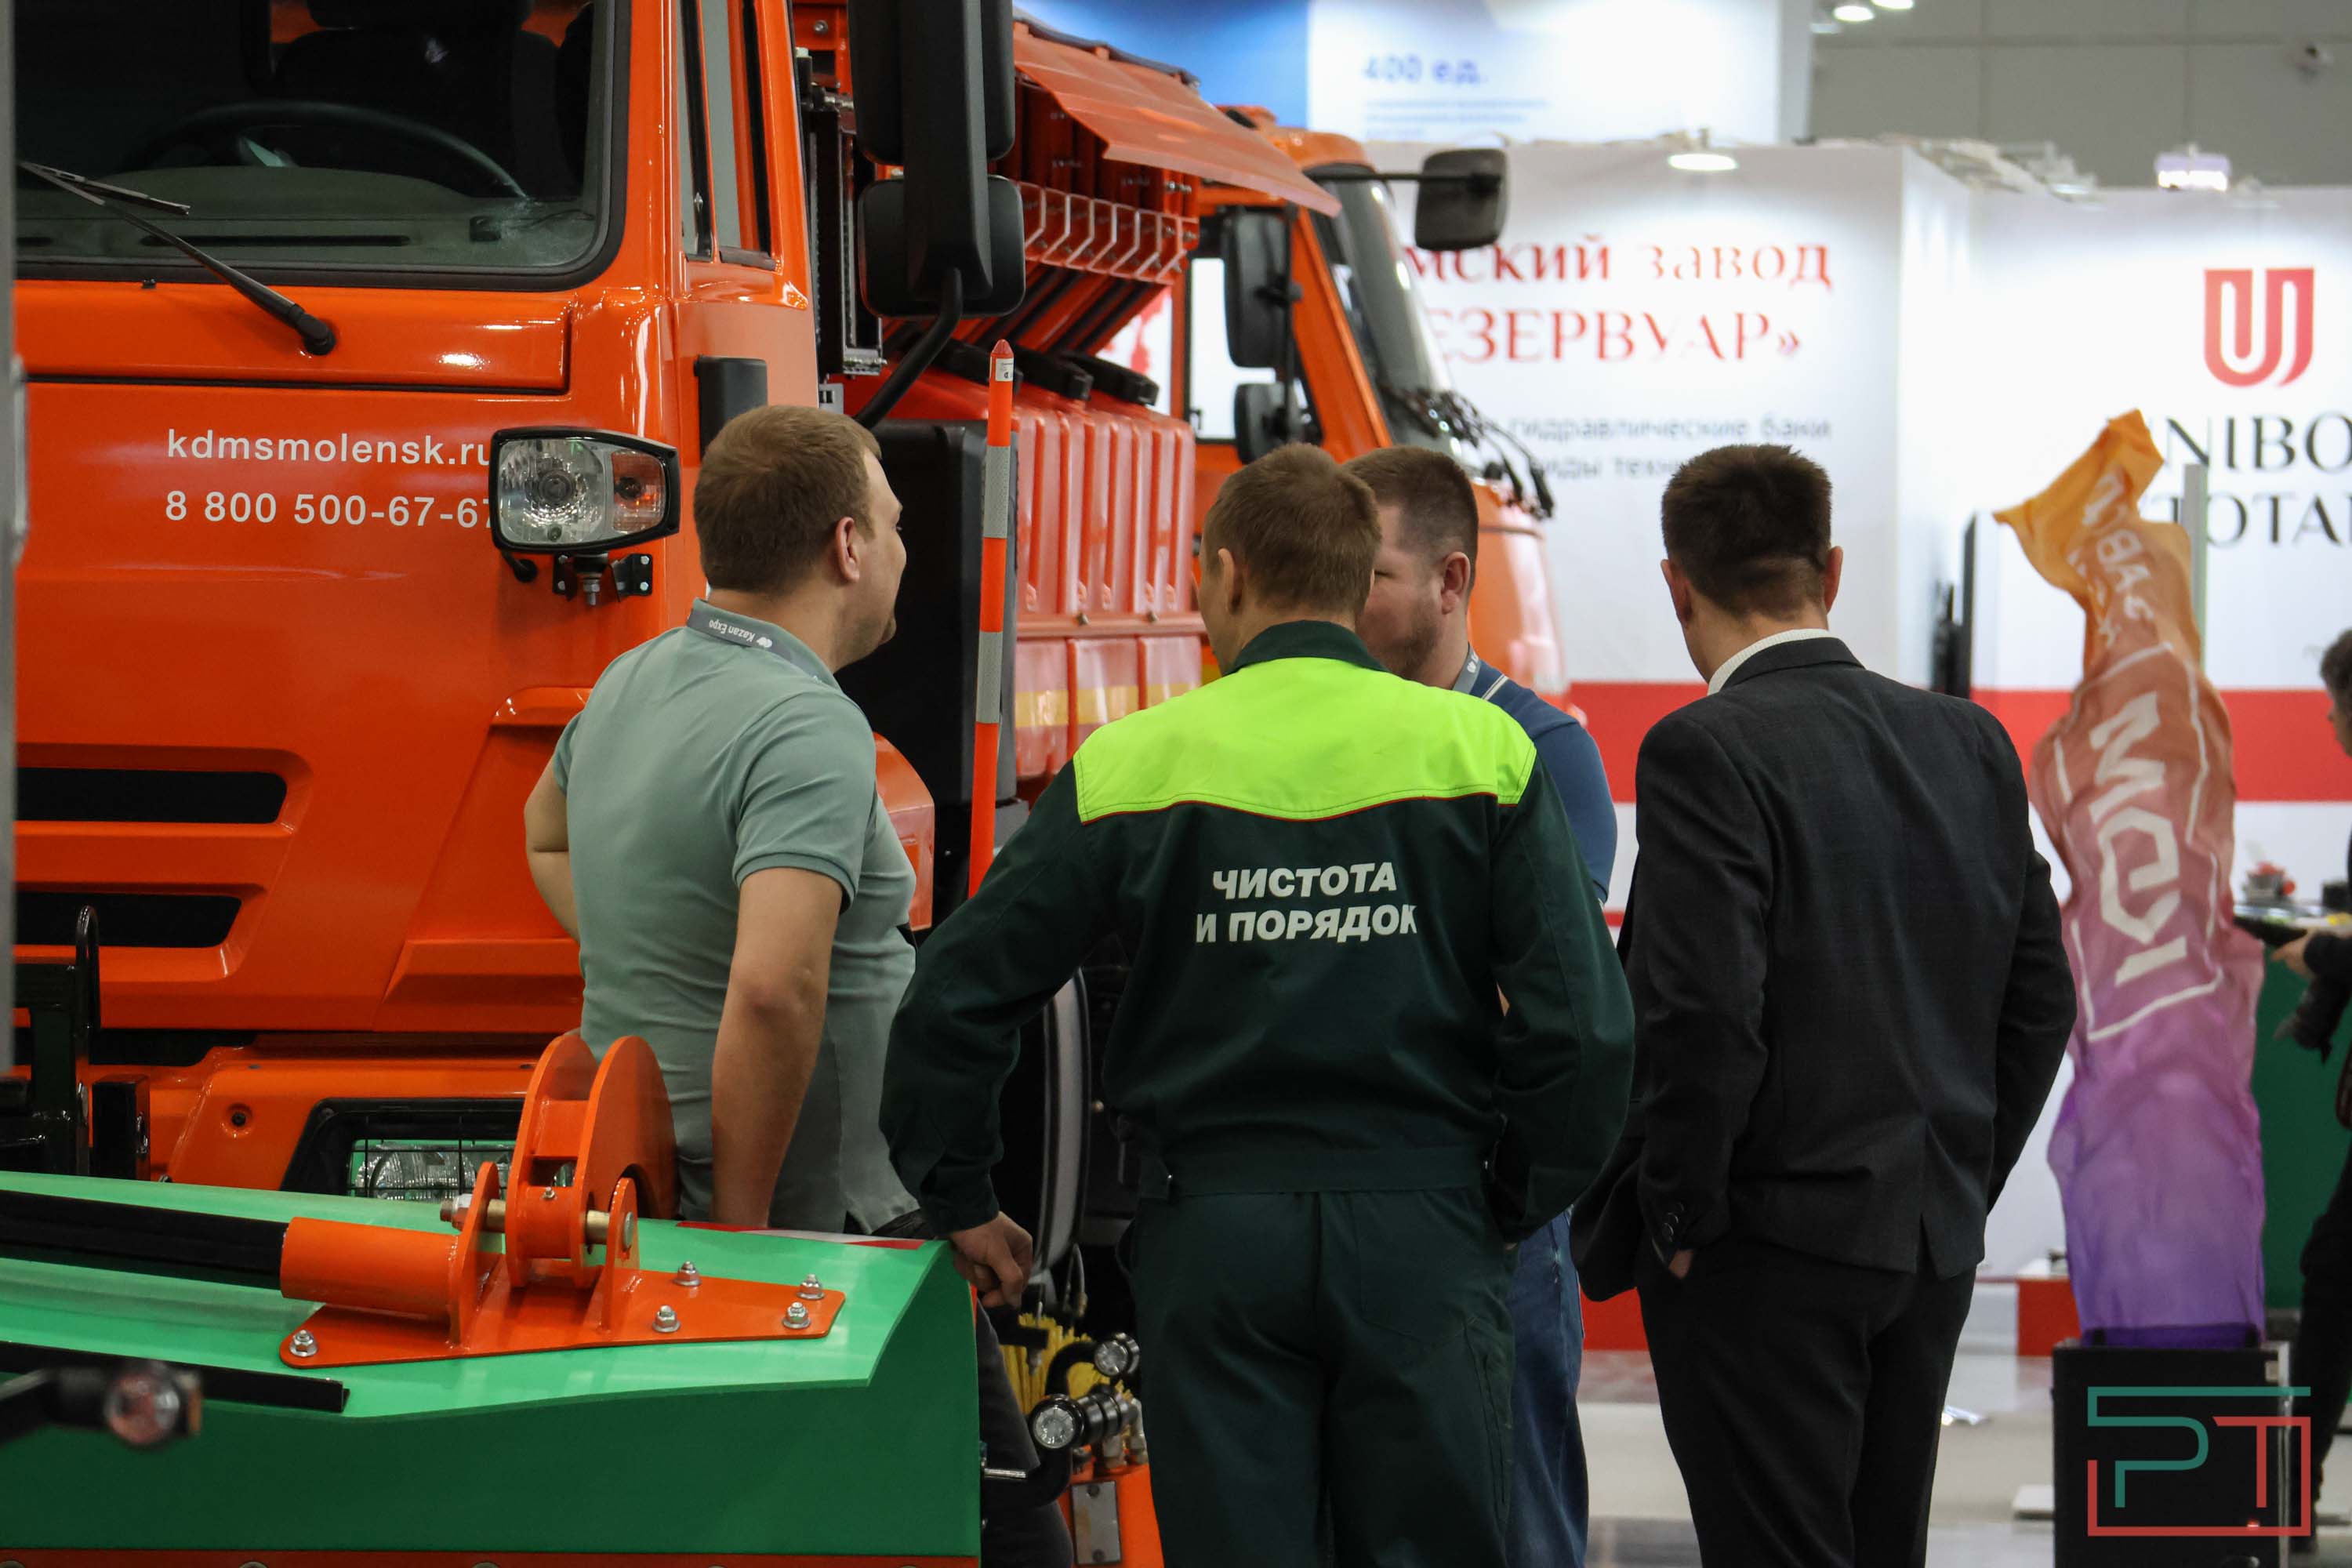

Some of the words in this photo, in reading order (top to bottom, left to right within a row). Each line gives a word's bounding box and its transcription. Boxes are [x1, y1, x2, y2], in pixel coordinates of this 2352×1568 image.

[167, 428, 490, 466] kdmsmolensk.ru
[2148, 412, 2352, 473] NIBO
[165, 490, 187, 521] 8
[204, 491, 277, 524] 800
[2151, 491, 2352, 546] TOTA
[709, 619, 728, 634] Expo
[728, 626, 756, 643] Kazan
[1212, 862, 1397, 900] ЧИСТОТА
[1196, 913, 1217, 943] И
[1229, 904, 1418, 943] ПОРЯДОК
